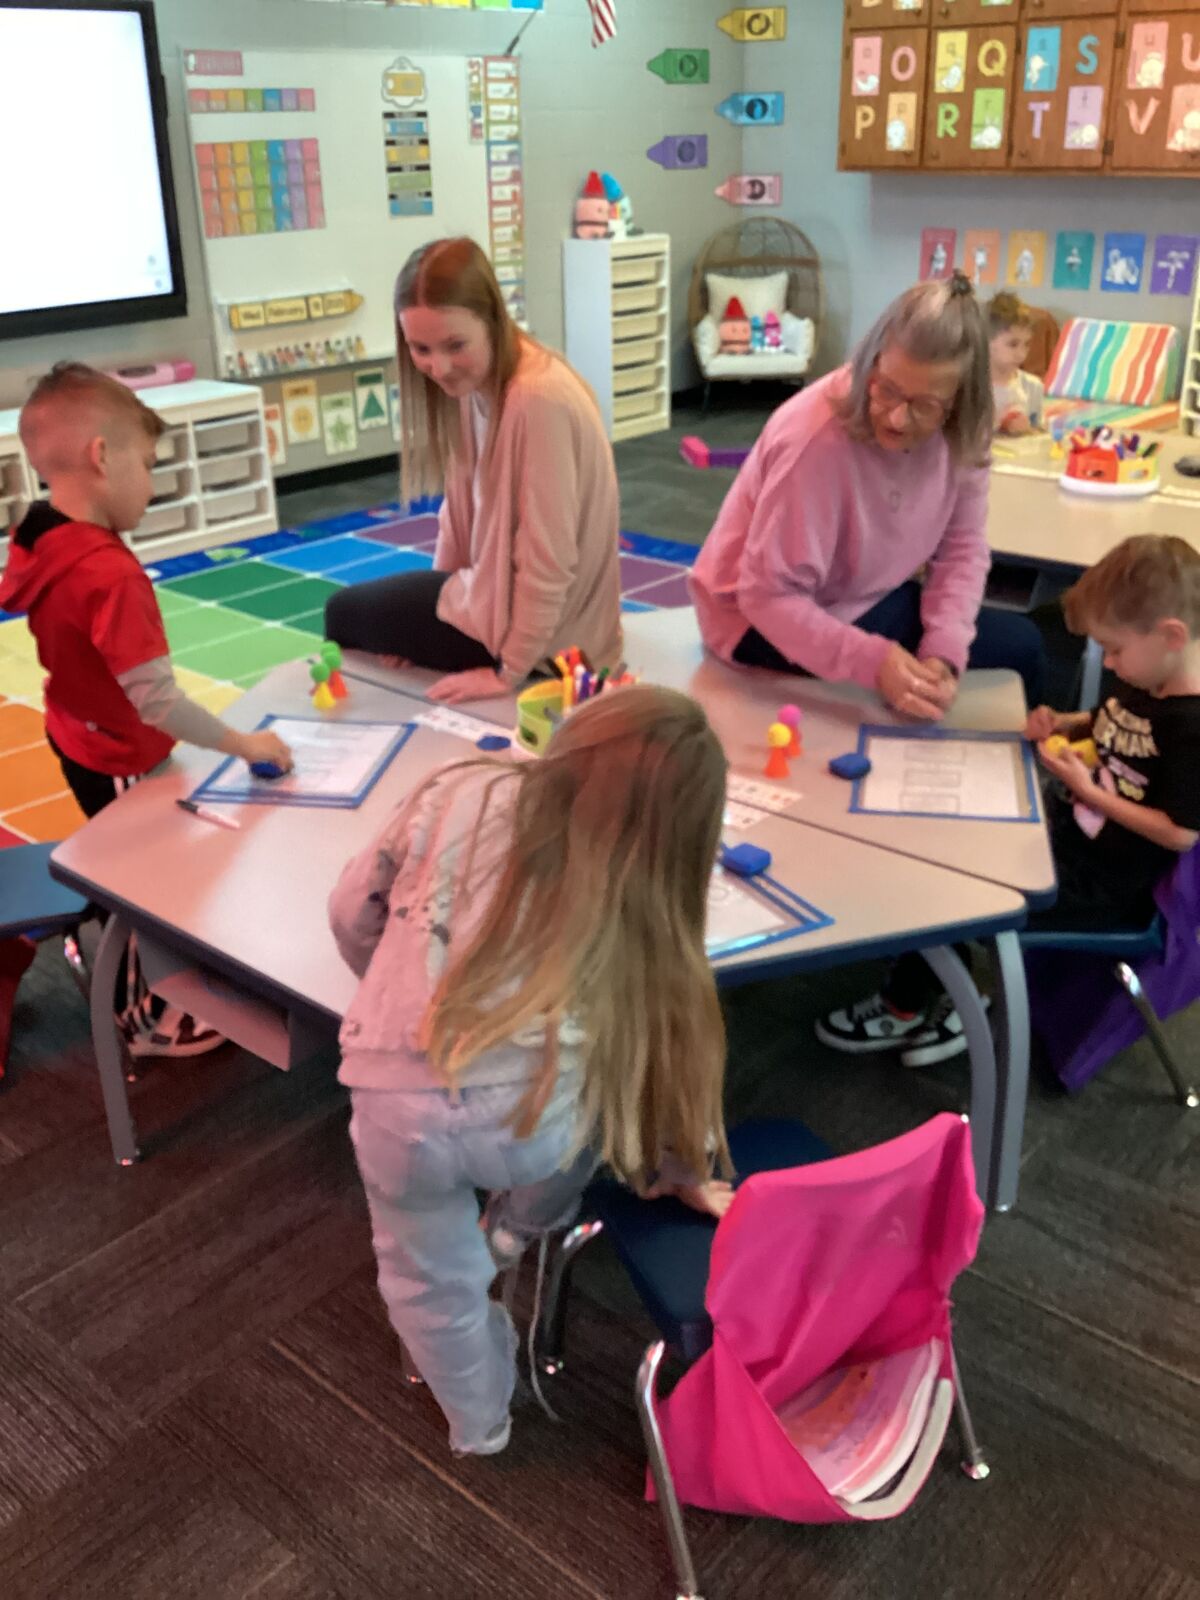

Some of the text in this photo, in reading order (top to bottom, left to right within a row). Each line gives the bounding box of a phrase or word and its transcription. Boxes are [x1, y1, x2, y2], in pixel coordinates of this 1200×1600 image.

[891, 46, 917, 82] O
[978, 39, 1007, 77] Q
[1075, 34, 1100, 75] S
[855, 105, 876, 140] P
[937, 102, 960, 139] R
[1028, 101, 1051, 139] T
[1125, 96, 1161, 135] V
